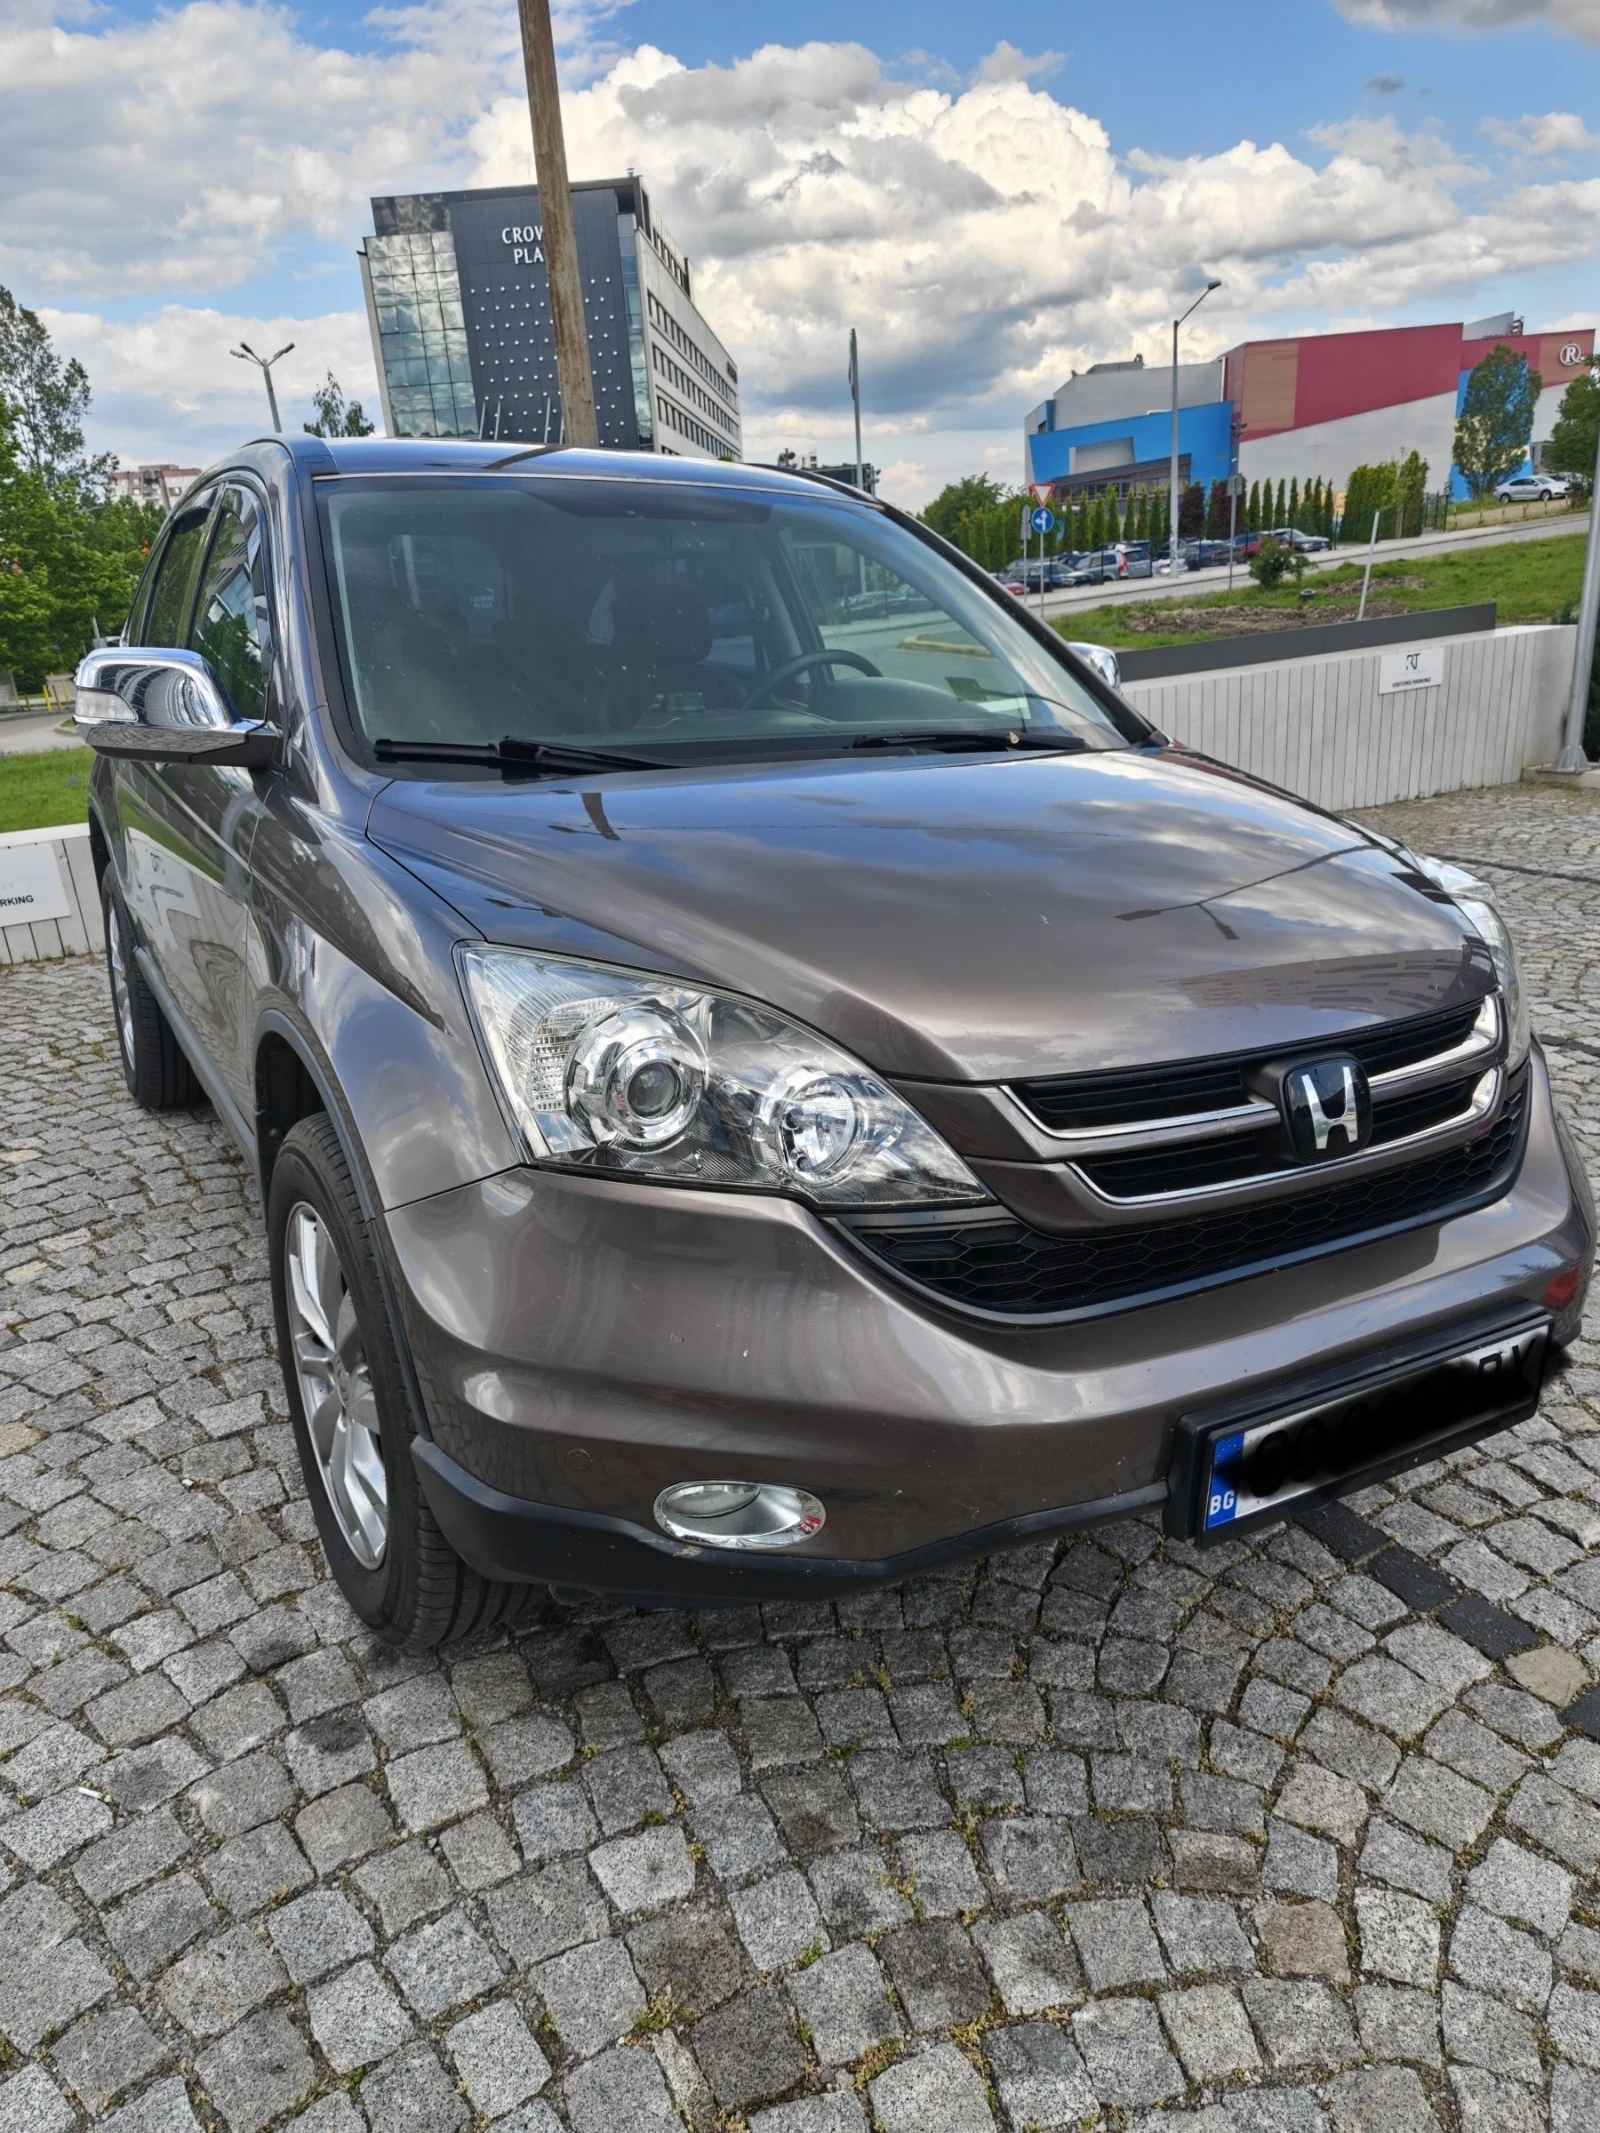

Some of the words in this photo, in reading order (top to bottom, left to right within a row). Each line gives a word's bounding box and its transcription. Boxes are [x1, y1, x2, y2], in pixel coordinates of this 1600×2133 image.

[501, 225, 543, 245] CROW
[513, 246, 545, 265] PLA
[1412, 677, 1432, 685] PARKING
[0, 894, 34, 907] RKING
[1209, 1489, 1236, 1516] BG
